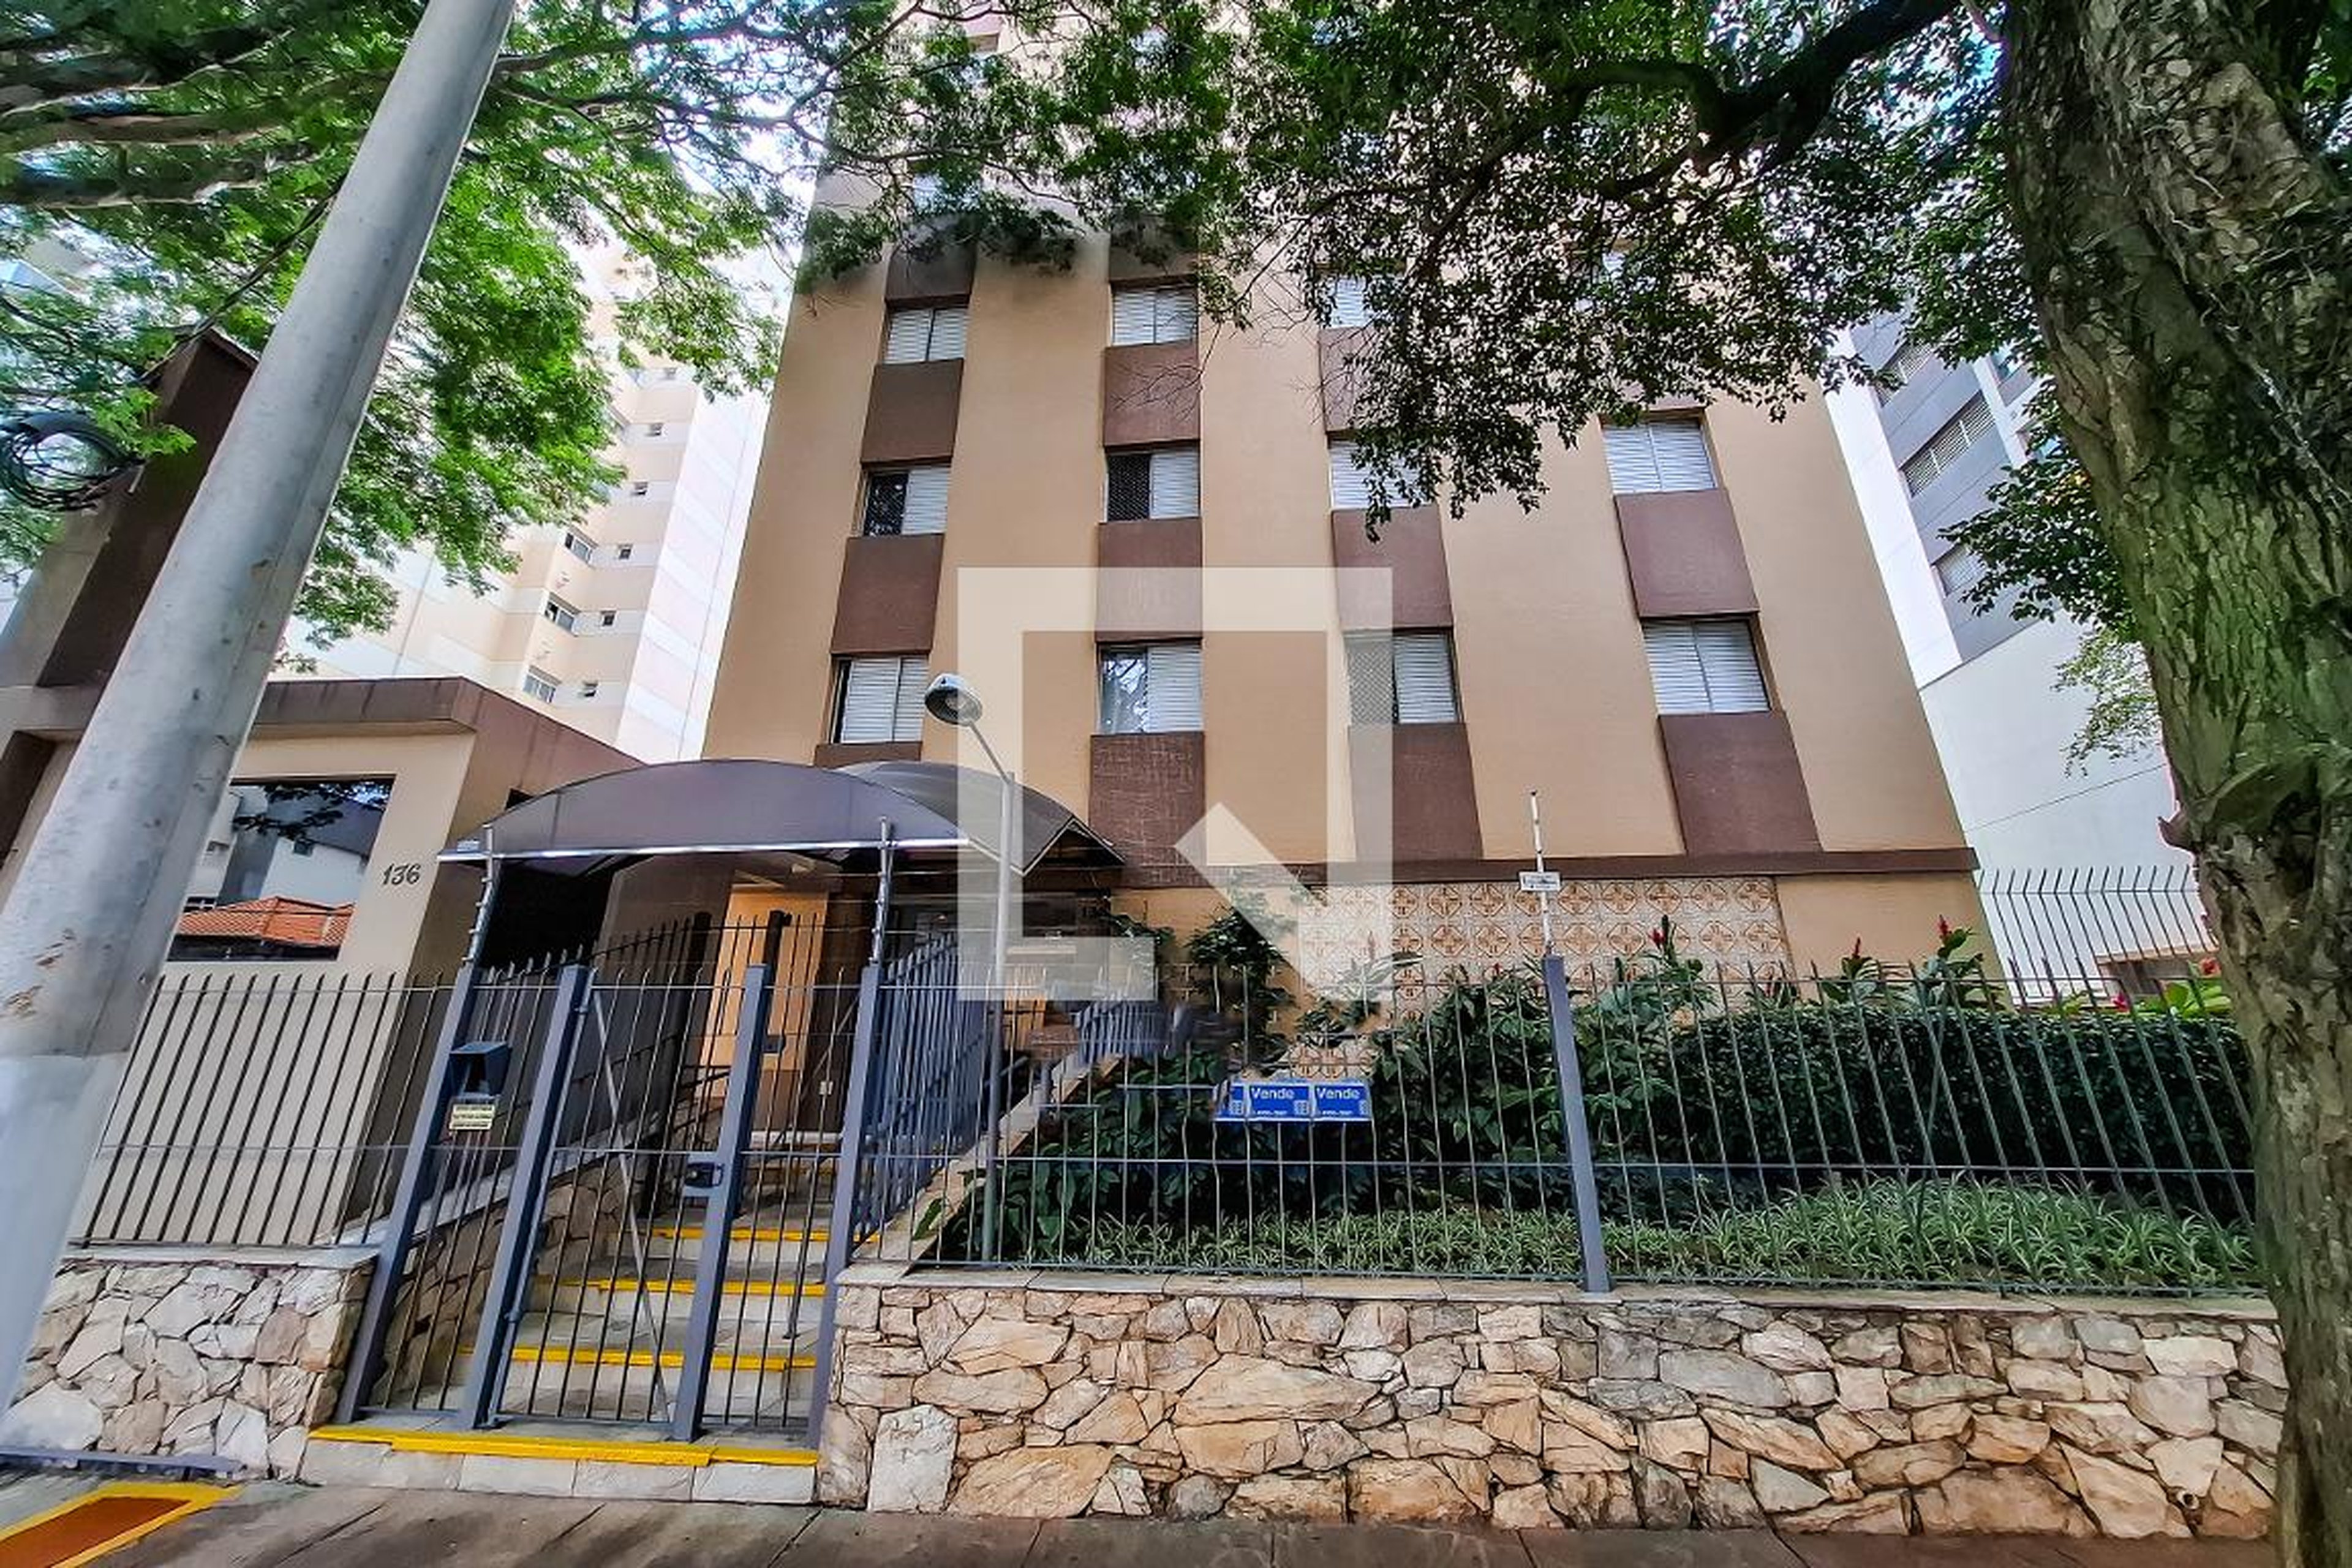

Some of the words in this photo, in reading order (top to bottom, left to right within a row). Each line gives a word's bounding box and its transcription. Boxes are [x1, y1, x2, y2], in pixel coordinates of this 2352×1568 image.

[383, 863, 421, 886] 136
[1251, 1087, 1295, 1099] Vende
[1316, 1087, 1360, 1099] Vende
